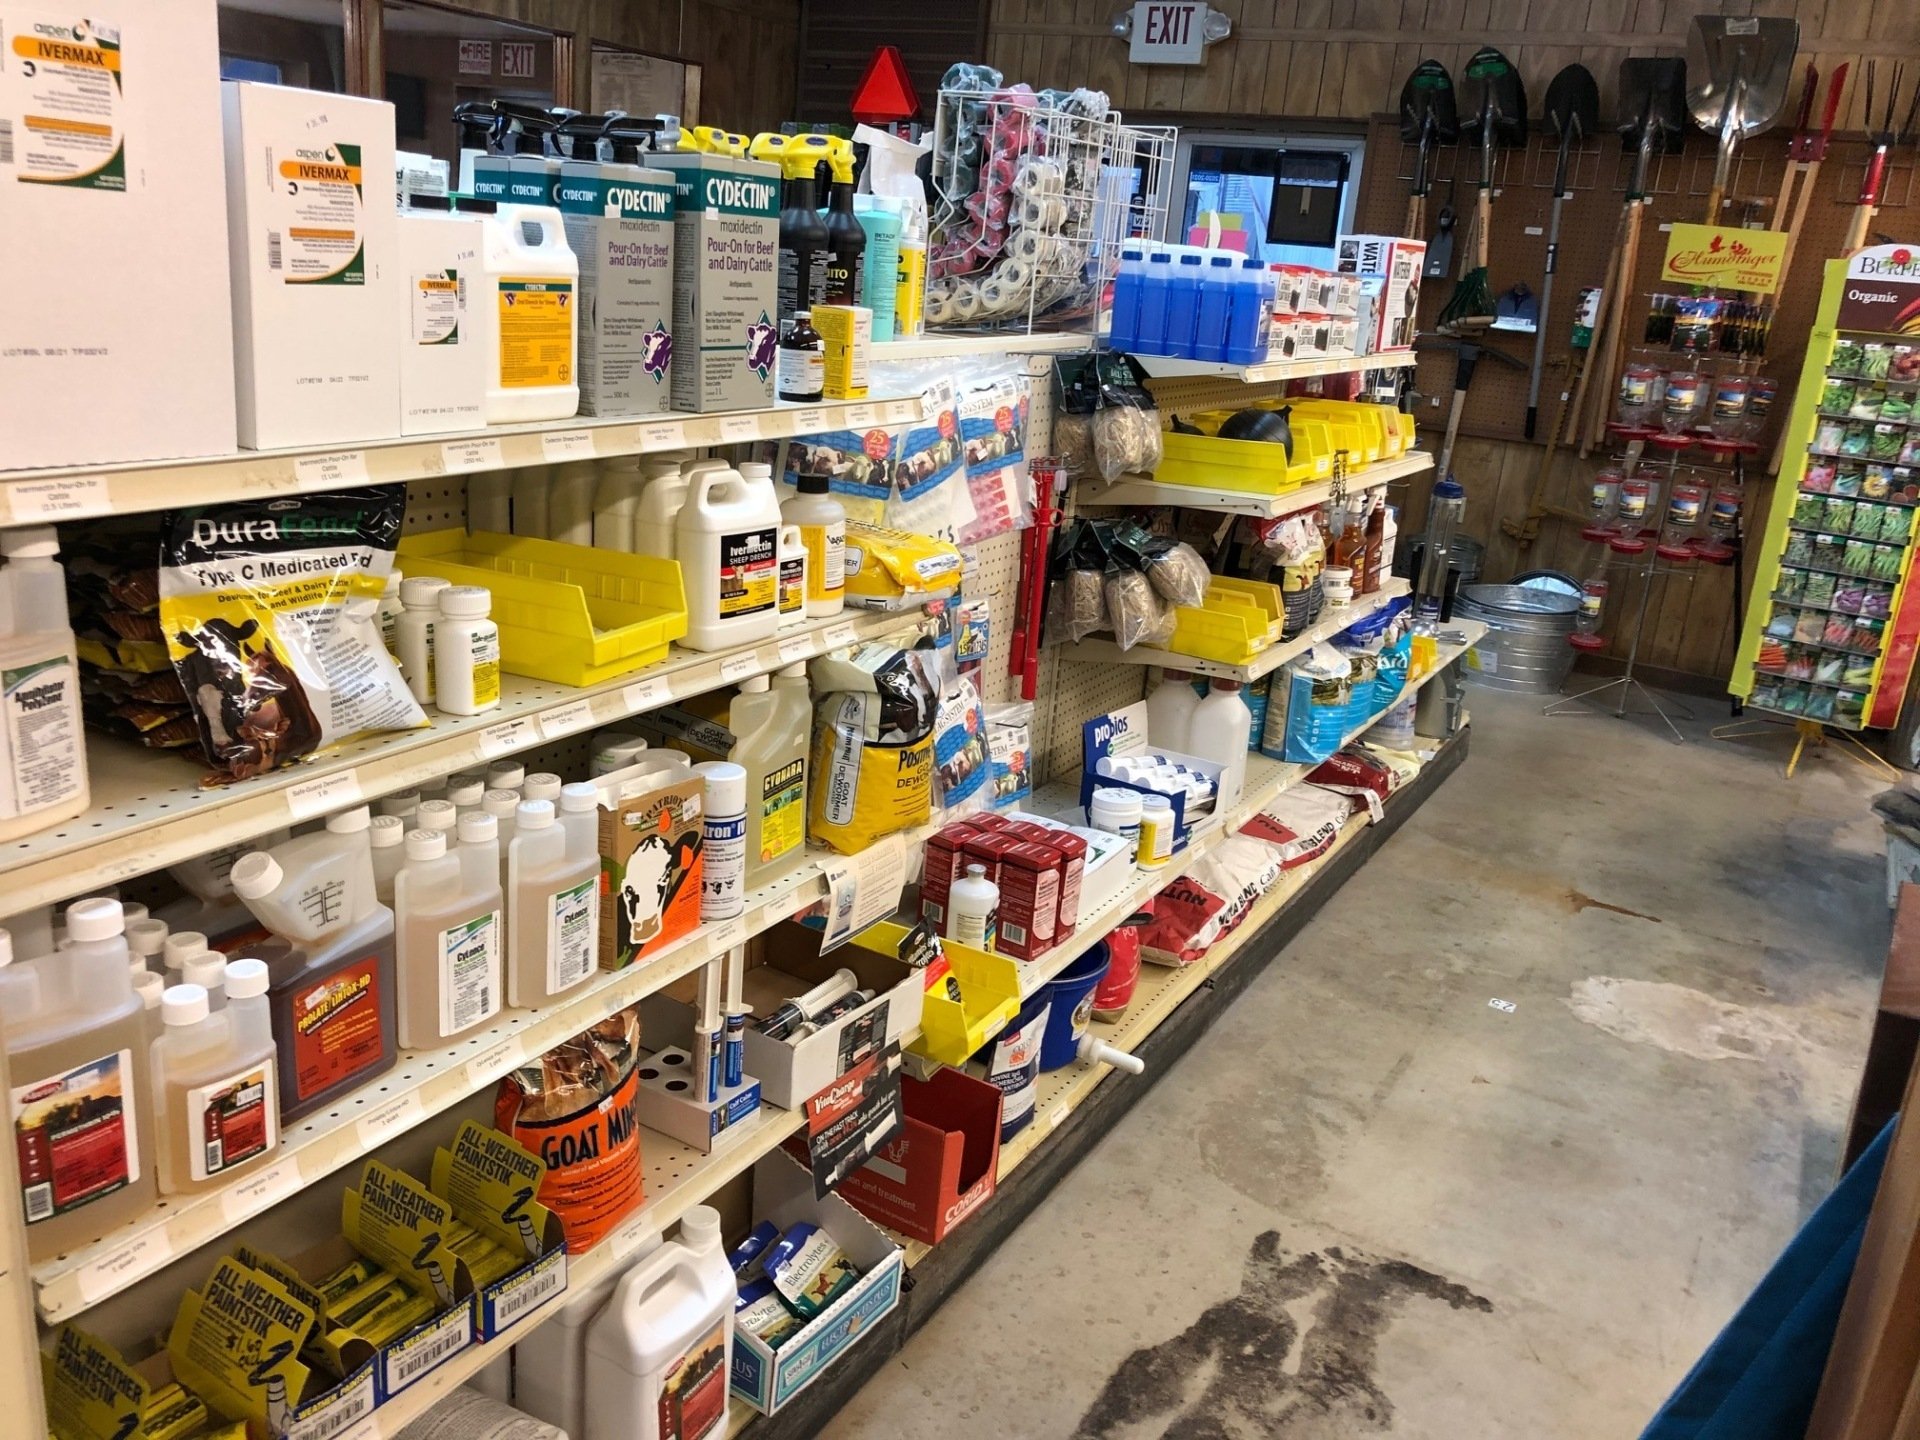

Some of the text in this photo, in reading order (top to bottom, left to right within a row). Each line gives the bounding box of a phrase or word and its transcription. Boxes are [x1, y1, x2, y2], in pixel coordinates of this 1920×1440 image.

[34, 23, 71, 38] aspen
[1145, 7, 1195, 45] EXIT
[38, 42, 104, 66] IVERMAX
[468, 43, 490, 60] FIRE
[503, 44, 534, 75] EXIT
[296, 149, 324, 160] aspen
[300, 165, 349, 180] IVERMAX
[619, 220, 660, 232] moxidectin
[720, 220, 763, 235] moxidectin
[608, 241, 669, 257] Pour-On for Beef
[707, 237, 774, 255] Pour-On for Beef
[1361, 242, 1379, 274] WATE
[609, 255, 668, 270] and Dairy Cattle
[708, 256, 773, 274] and Dairy Cattle
[1858, 256, 1920, 277] BURPE
[1848, 289, 1899, 304] Organic
[870, 431, 884, 443] 25
[729, 551, 772, 566] SHEEP DRENCH
[730, 541, 772, 557] Ivermectin
[194, 553, 348, 588] Type C Medicated
[304, 582, 327, 592] Dairy
[271, 592, 323, 610] and Wildlife
[703, 727, 724, 739] GOAT
[1095, 716, 1128, 748] probios
[898, 746, 931, 773] POSITIV
[917, 763, 930, 775] GO
[833, 765, 846, 820] DEWORMER
[841, 781, 850, 807] GOAT
[833, 1119, 845, 1132] FAST
[844, 1110, 859, 1124] TRACK
[461, 1126, 540, 1182] ALL-WEATHER
[541, 1123, 600, 1171] GOAT
[454, 1142, 515, 1187] PAINTSTIK
[362, 1187, 421, 1232] PAINTSTIK
[366, 1166, 446, 1227] ALL-WEATHER
[863, 1181, 878, 1194] and
[878, 1186, 918, 1213] treatment.
[487, 1250, 563, 1302] ALL-WEATHER PAINTSTIK
[785, 1240, 828, 1287] Electrolytes
[206, 1282, 275, 1340] PAINTSTIK
[214, 1264, 306, 1334] ALL-WEATHER
[387, 1300, 471, 1359] ALL-WEATHER PAINTSTIK
[57, 1345, 117, 1410] PAINTSTIK
[60, 1326, 144, 1406] ALL-WEATHER
[338, 1365, 374, 1399] PAINTSTIK
